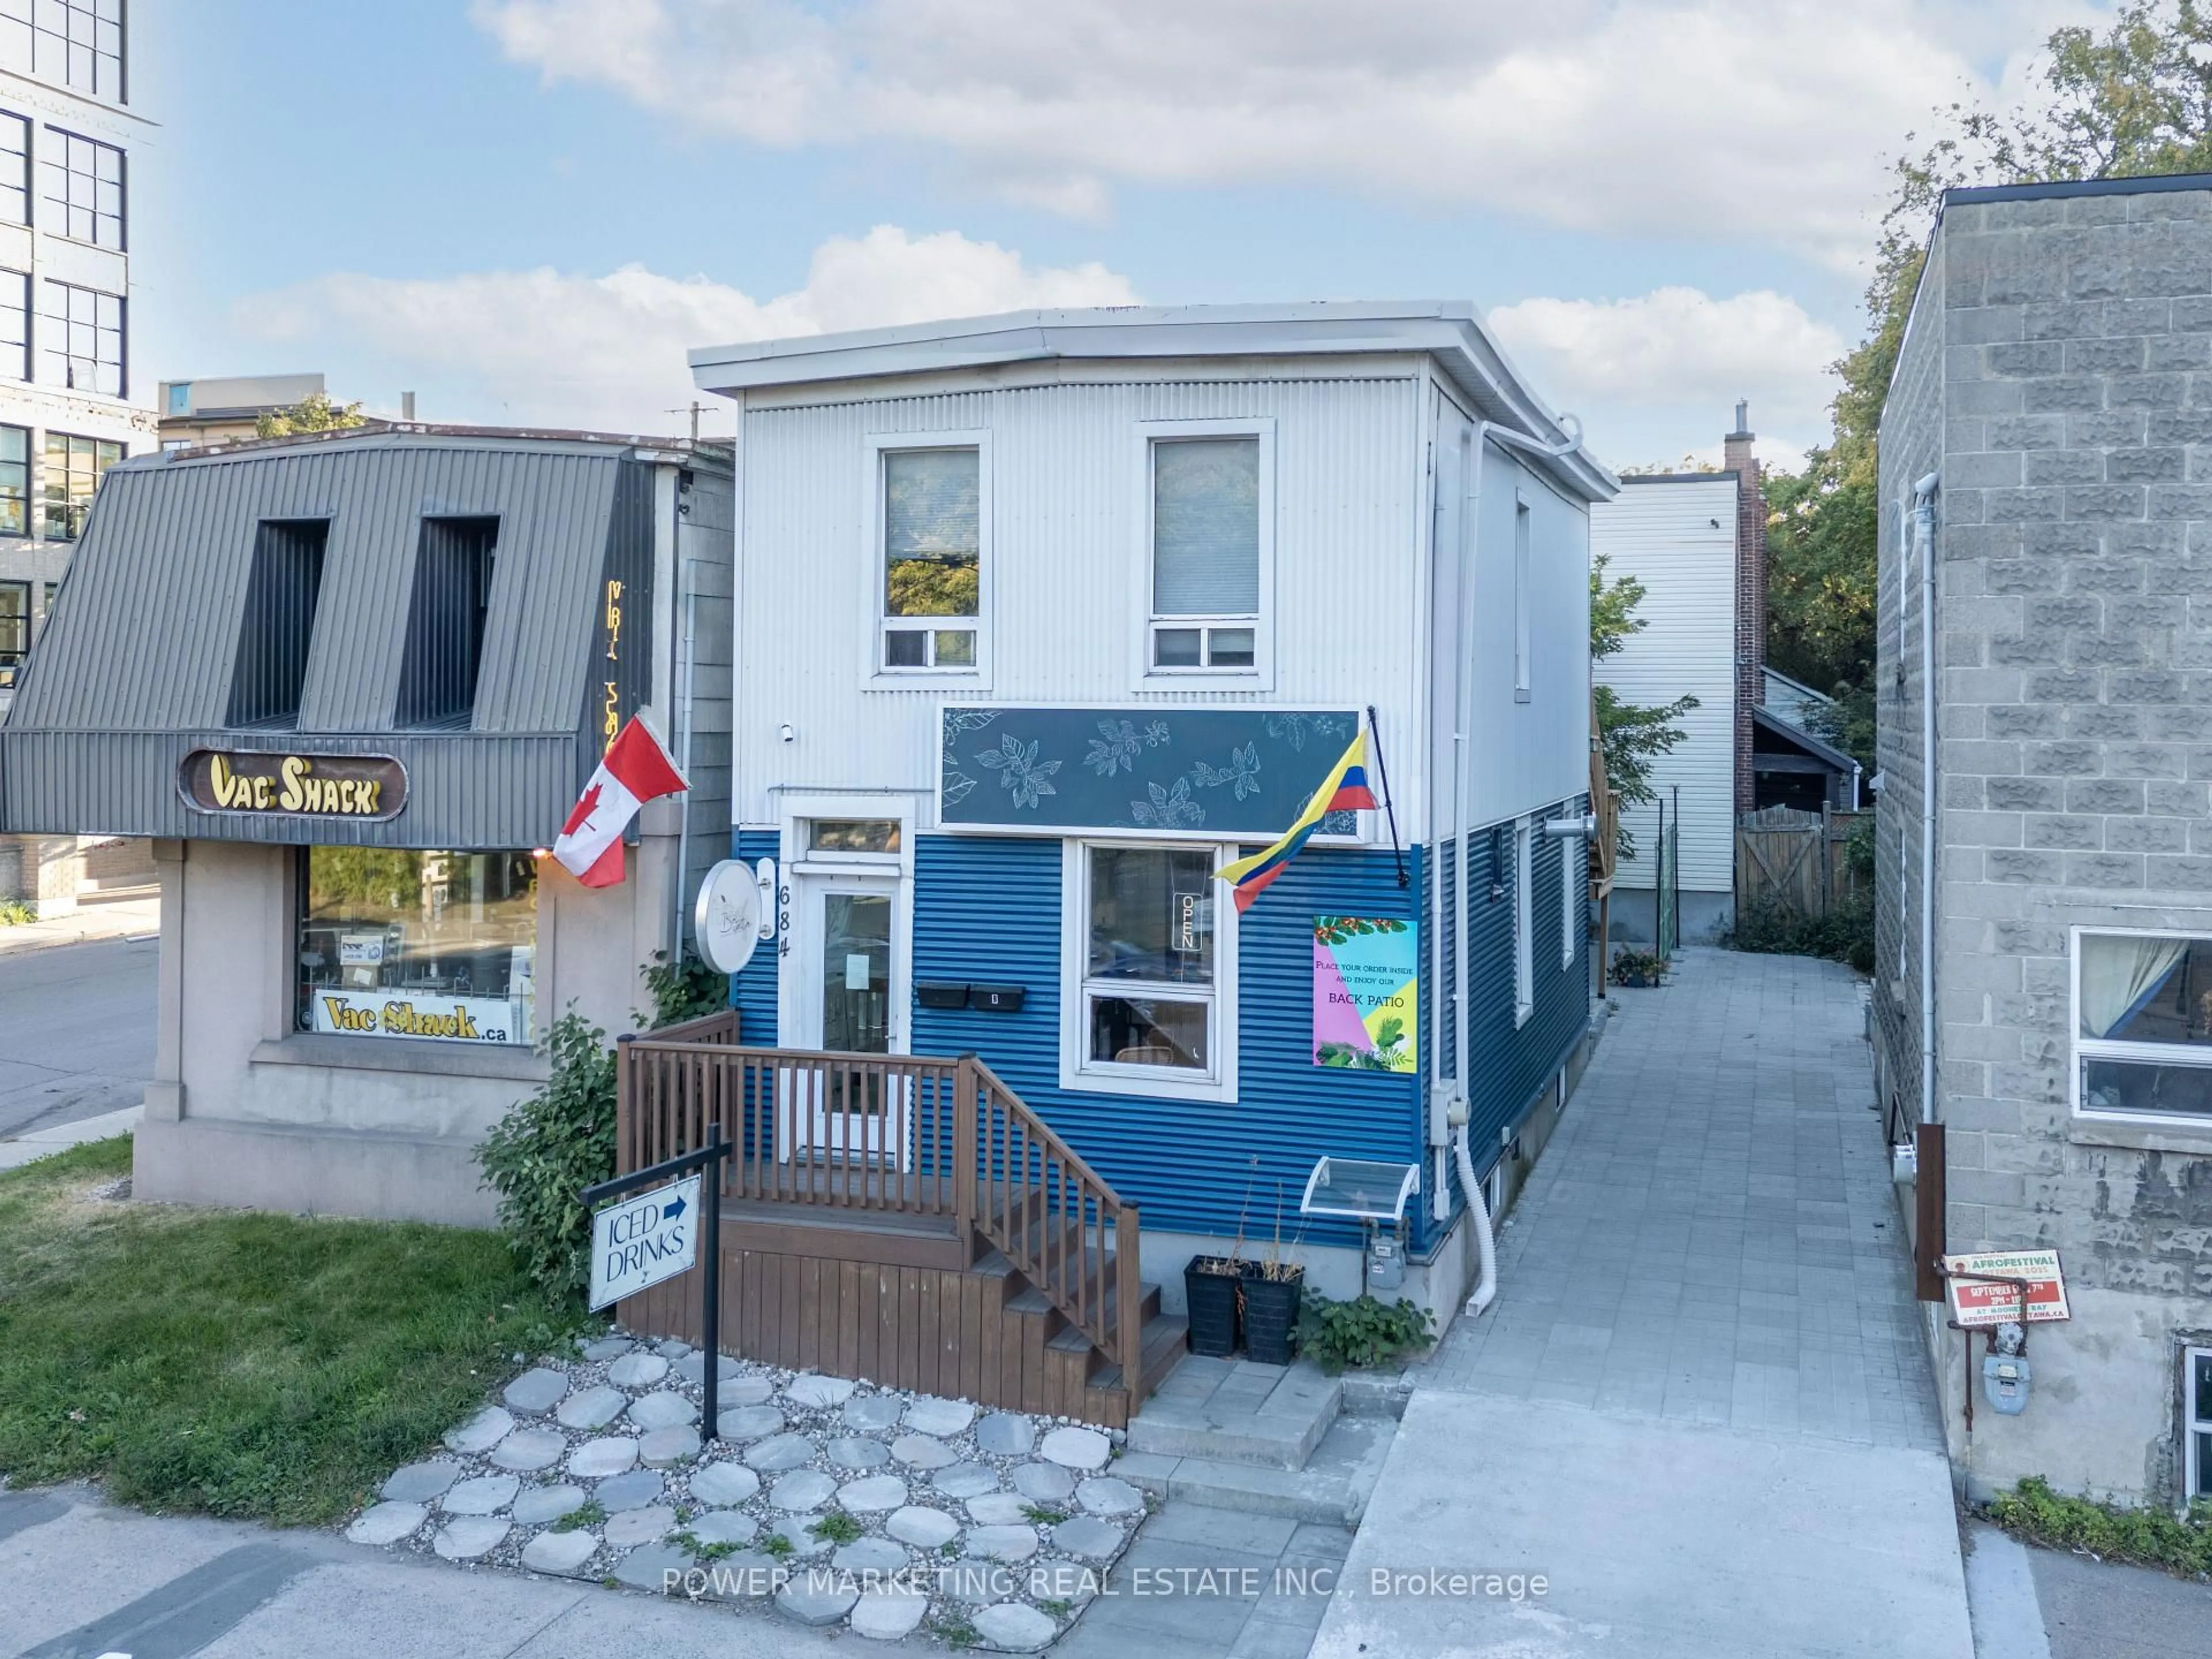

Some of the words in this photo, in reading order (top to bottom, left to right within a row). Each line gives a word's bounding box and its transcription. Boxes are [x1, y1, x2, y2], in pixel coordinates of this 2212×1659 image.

[779, 885, 790, 957] 684
[1182, 896, 1193, 948] OPEN
[1336, 975, 1352, 983] AND
[1355, 976, 1376, 984] ENJOY
[323, 997, 377, 1032] Vac
[1329, 993, 1363, 1005] BACK
[1368, 995, 1404, 1007] PATIO
[609, 1204, 658, 1248] ICED
[607, 1225, 684, 1282] DRINKS
[1972, 1256, 2055, 1270] AFROFESTIVAL
[1971, 1283, 2011, 1297] SEPTEMBER
